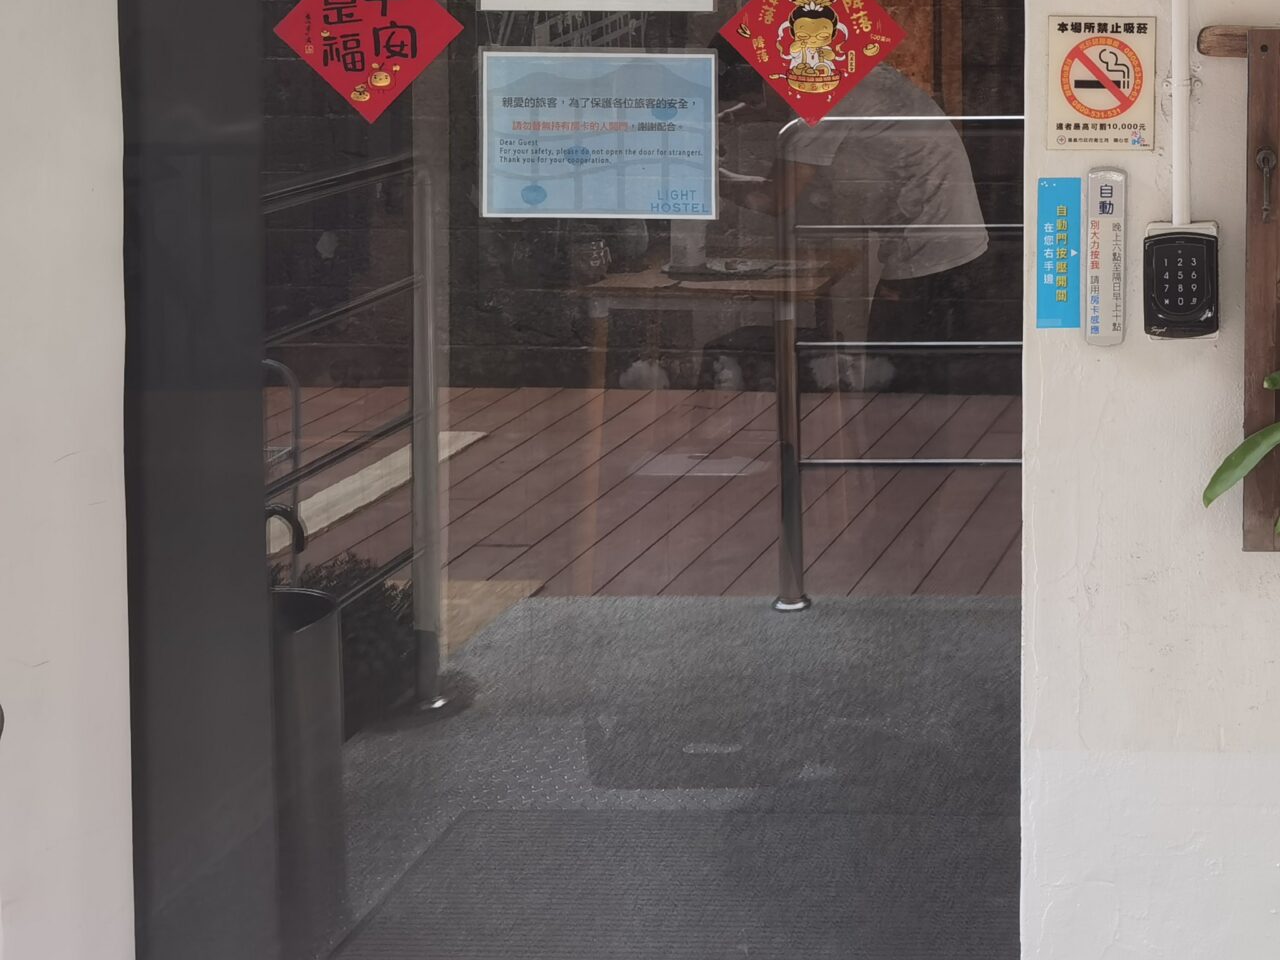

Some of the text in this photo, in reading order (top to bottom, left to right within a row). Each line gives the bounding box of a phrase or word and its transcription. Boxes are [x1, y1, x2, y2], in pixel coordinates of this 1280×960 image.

[1057, 22, 1148, 34] 本場所禁止吸菸
[513, 149, 529, 157] your
[556, 148, 579, 157] please
[537, 156, 548, 164] for
[657, 190, 697, 201] LIGHT
[1099, 184, 1114, 215] 自動
[651, 202, 709, 213] HOSTEL
[1090, 220, 1100, 270] 別大力按我
[1056, 204, 1068, 302] 自動門按壓開關
